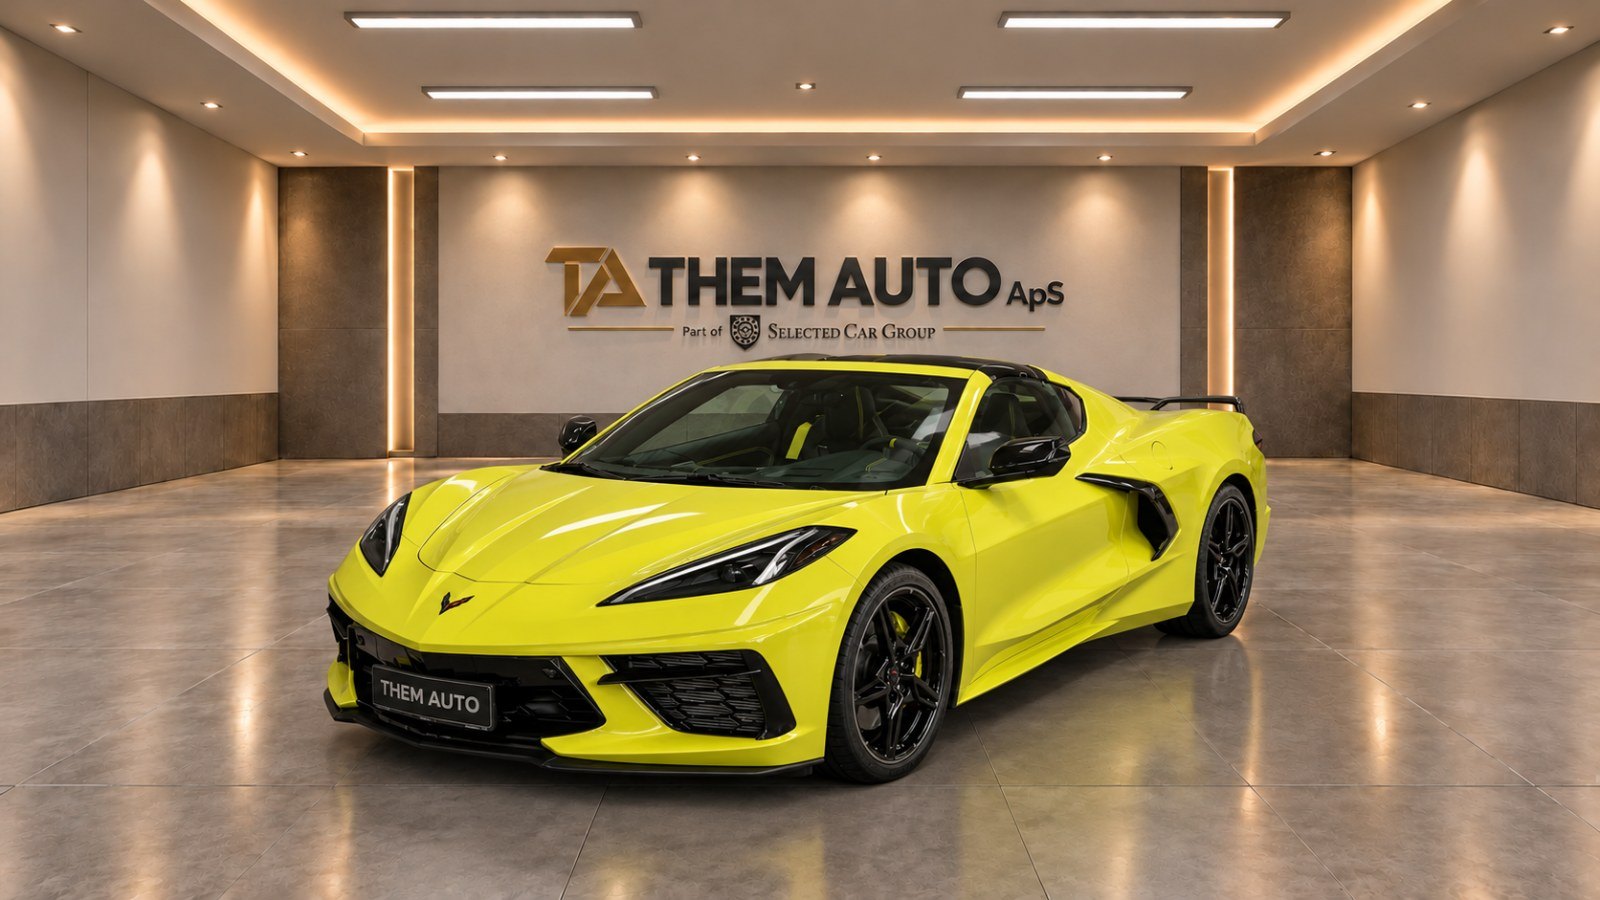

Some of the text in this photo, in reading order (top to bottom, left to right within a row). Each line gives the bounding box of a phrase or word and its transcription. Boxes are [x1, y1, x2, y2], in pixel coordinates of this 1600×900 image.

[648, 256, 1065, 312] THEM AUTO ApS
[682, 323, 936, 340] Part of SELECTED CAR GROUP
[380, 679, 480, 713] THEM AUTO
